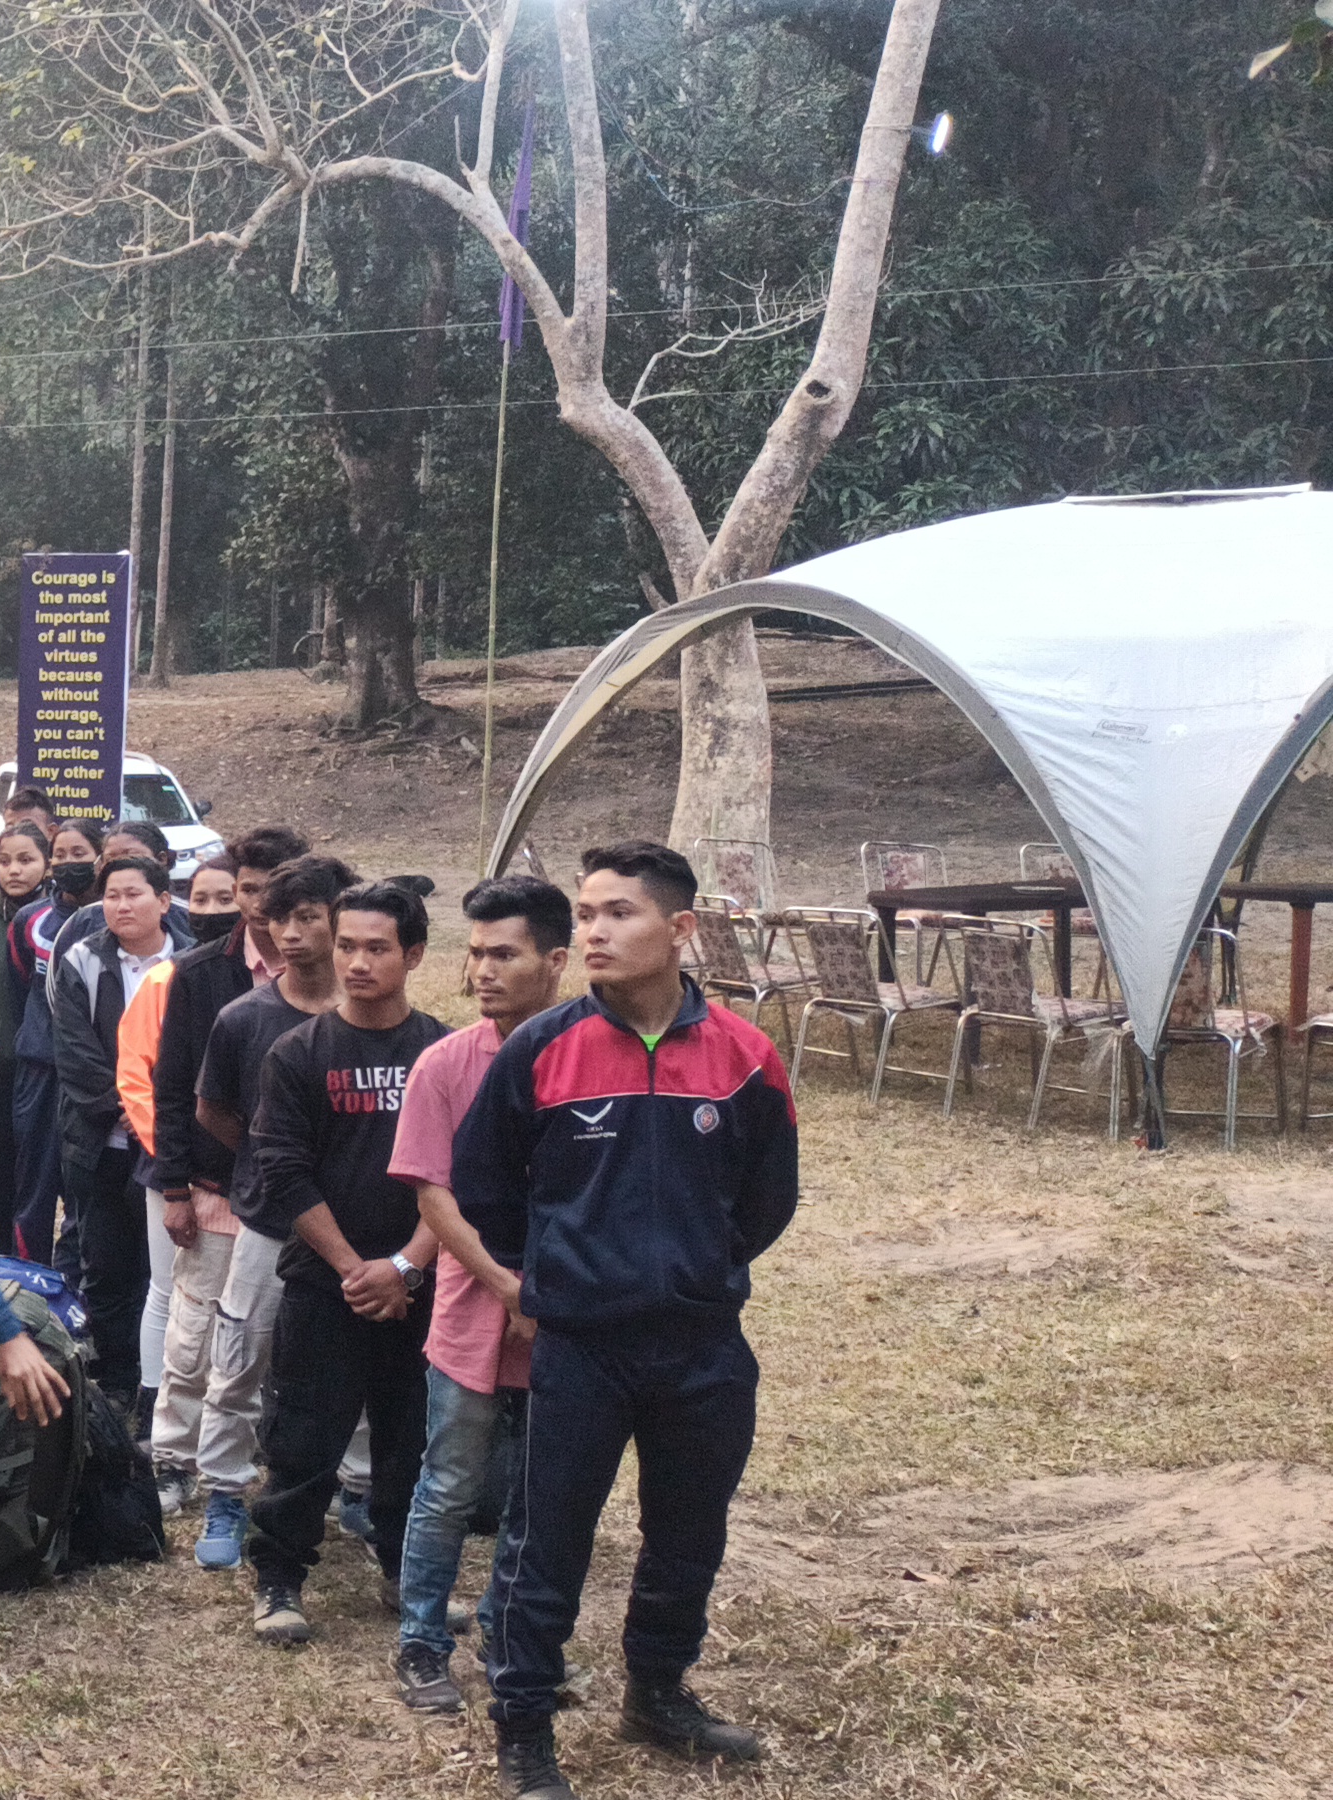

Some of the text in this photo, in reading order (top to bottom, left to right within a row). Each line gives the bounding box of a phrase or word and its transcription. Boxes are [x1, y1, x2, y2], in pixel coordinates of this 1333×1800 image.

[32, 571, 115, 587] Courage is
[39, 591, 107, 604] the most
[36, 611, 110, 626] important
[38, 630, 105, 643] of all the
[45, 650, 97, 663] virtues
[39, 669, 102, 682] because
[42, 689, 99, 701] without
[37, 709, 102, 723] courage,
[34, 727, 104, 742] you can't
[38, 747, 99, 761] practice
[33, 766, 104, 781] any other
[46, 785, 89, 798] virtue
[54, 804, 115, 821] istently.
